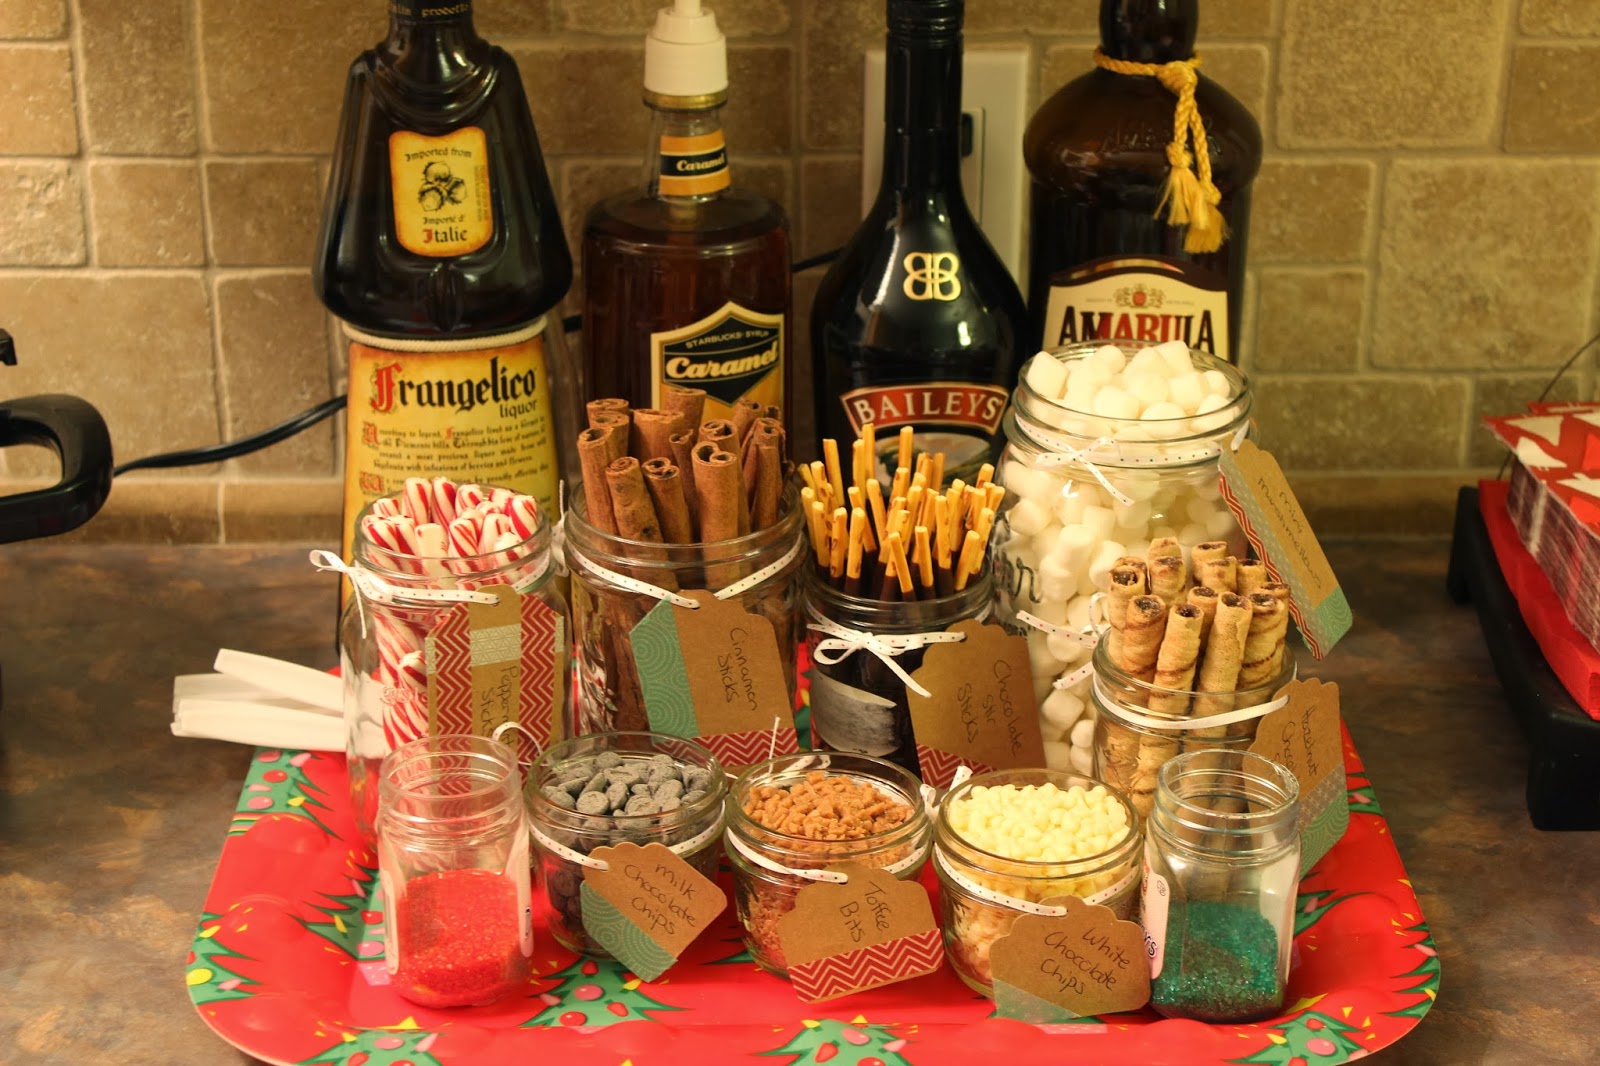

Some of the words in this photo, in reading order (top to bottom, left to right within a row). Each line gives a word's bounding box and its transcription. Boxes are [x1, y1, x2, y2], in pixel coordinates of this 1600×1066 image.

[404, 147, 448, 161] Imported
[451, 147, 472, 158] from
[676, 153, 725, 171] Caramel
[685, 331, 741, 349] STARBUCKS
[1058, 305, 1216, 354] AMARULA
[666, 340, 779, 379] Caramel
[370, 356, 536, 414] Frangelico
[500, 399, 538, 419] liquor
[853, 391, 1003, 424] BAILEYS
[717, 653, 740, 703] Sticks
[957, 683, 979, 744] Sticks
[993, 660, 1025, 758] Chocolate
[624, 864, 696, 928] Chocolate
[632, 897, 675, 935] Chips
[864, 881, 892, 933] Toffee
[840, 901, 865, 943] Bits
[1044, 931, 1117, 991] Chocolate
[1083, 927, 1131, 970] White
[1040, 959, 1086, 995] Chips
